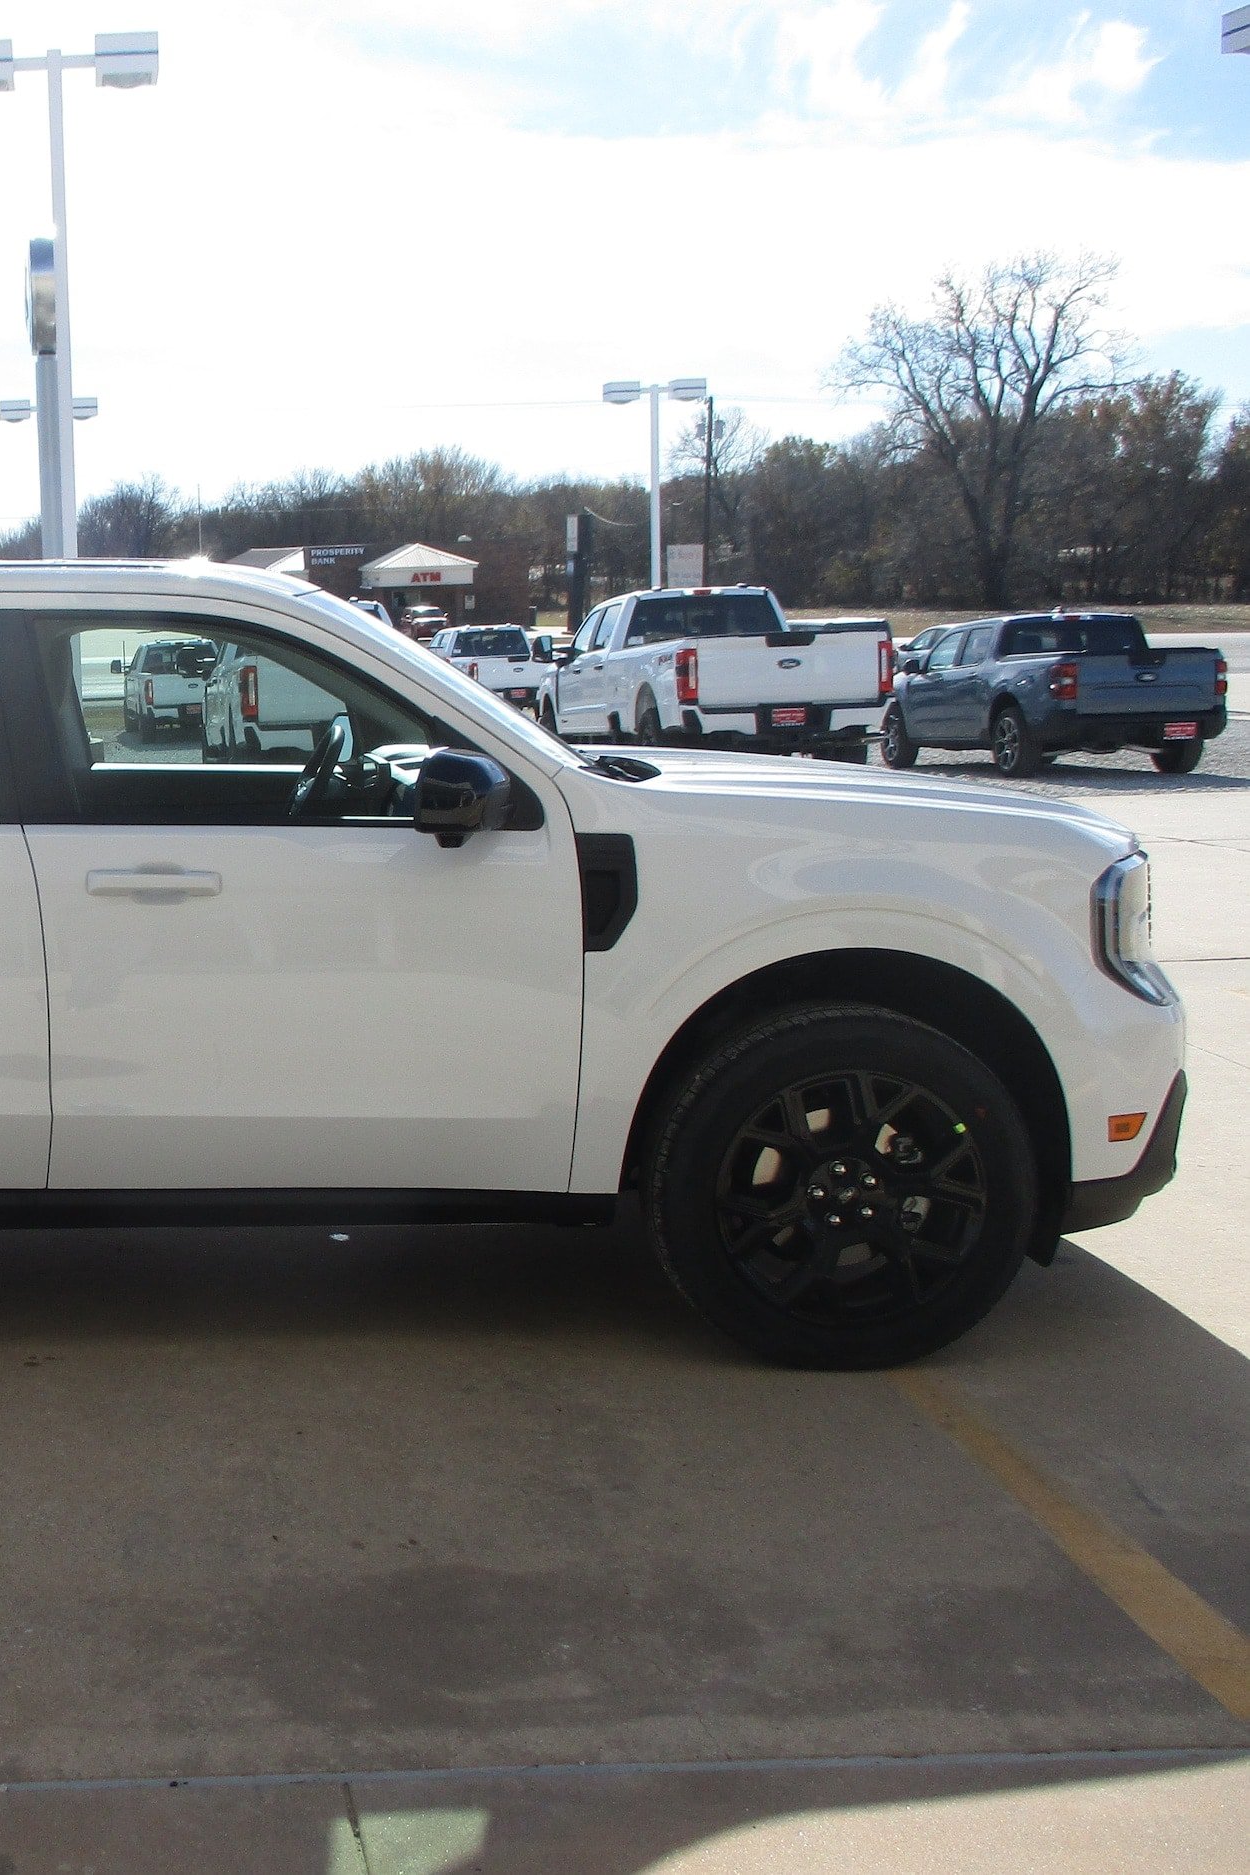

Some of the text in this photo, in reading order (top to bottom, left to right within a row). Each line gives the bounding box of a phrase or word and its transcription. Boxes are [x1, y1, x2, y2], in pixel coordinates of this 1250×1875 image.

[311, 547, 365, 557] PROSPERITY
[311, 557, 336, 565] BANK
[410, 571, 441, 583] ATM
